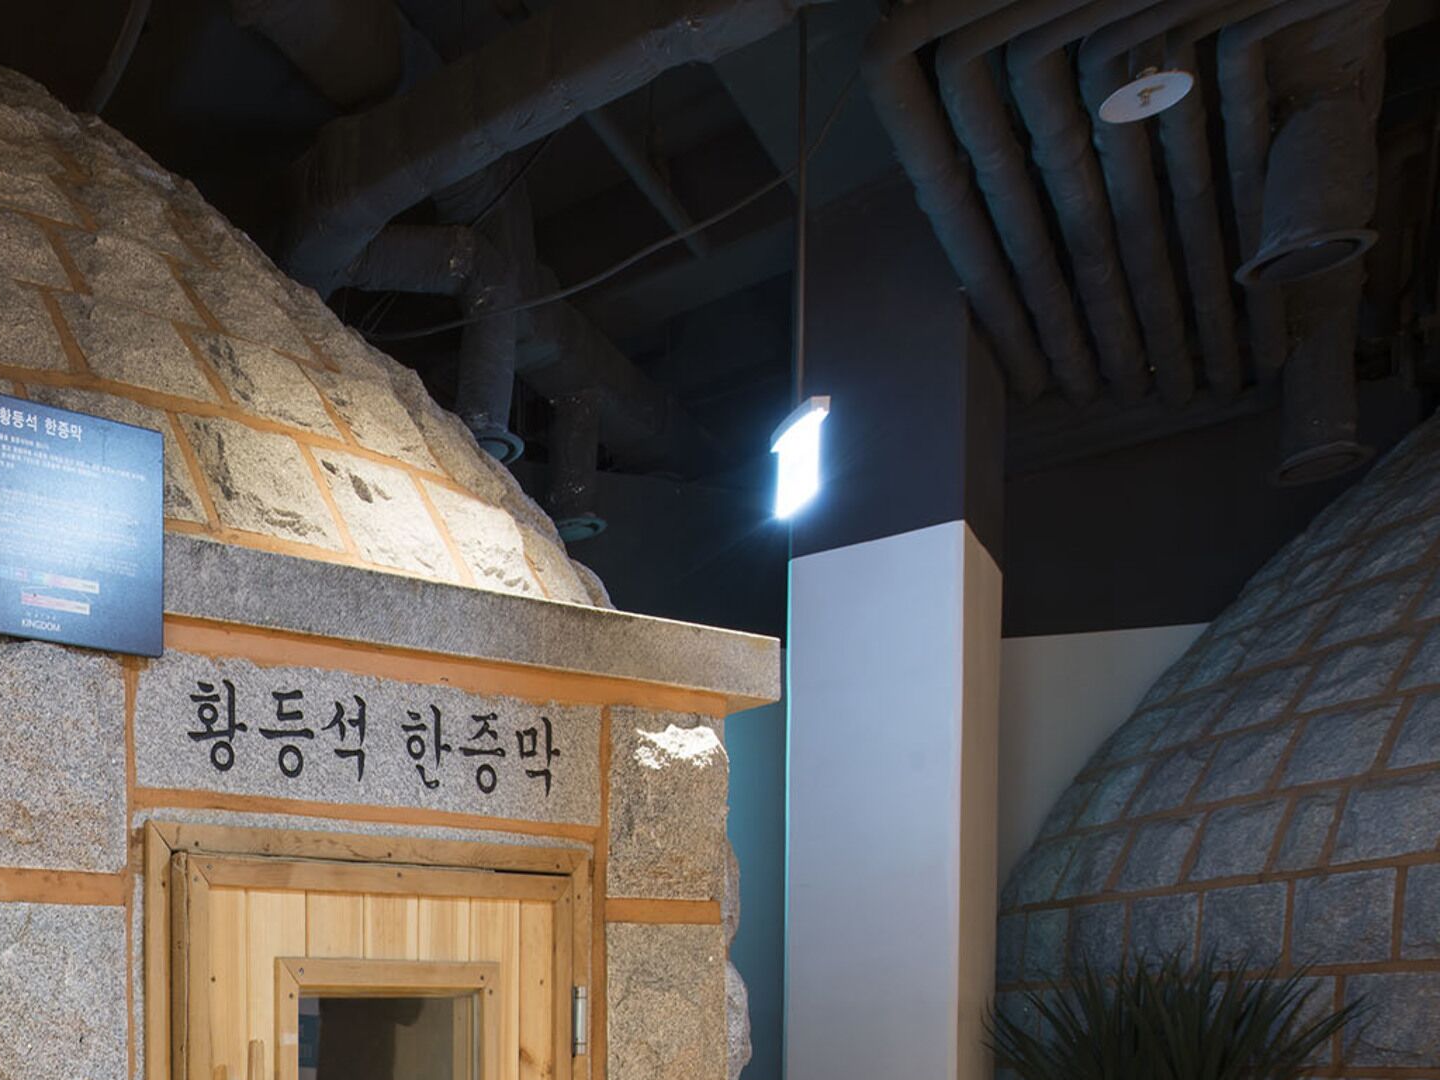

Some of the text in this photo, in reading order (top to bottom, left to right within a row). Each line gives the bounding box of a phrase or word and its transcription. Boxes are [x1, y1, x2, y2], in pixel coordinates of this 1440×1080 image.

[0, 406, 38, 431] 황등석
[44, 416, 83, 442] 한증막
[187, 679, 560, 797] 황등석 한증막
